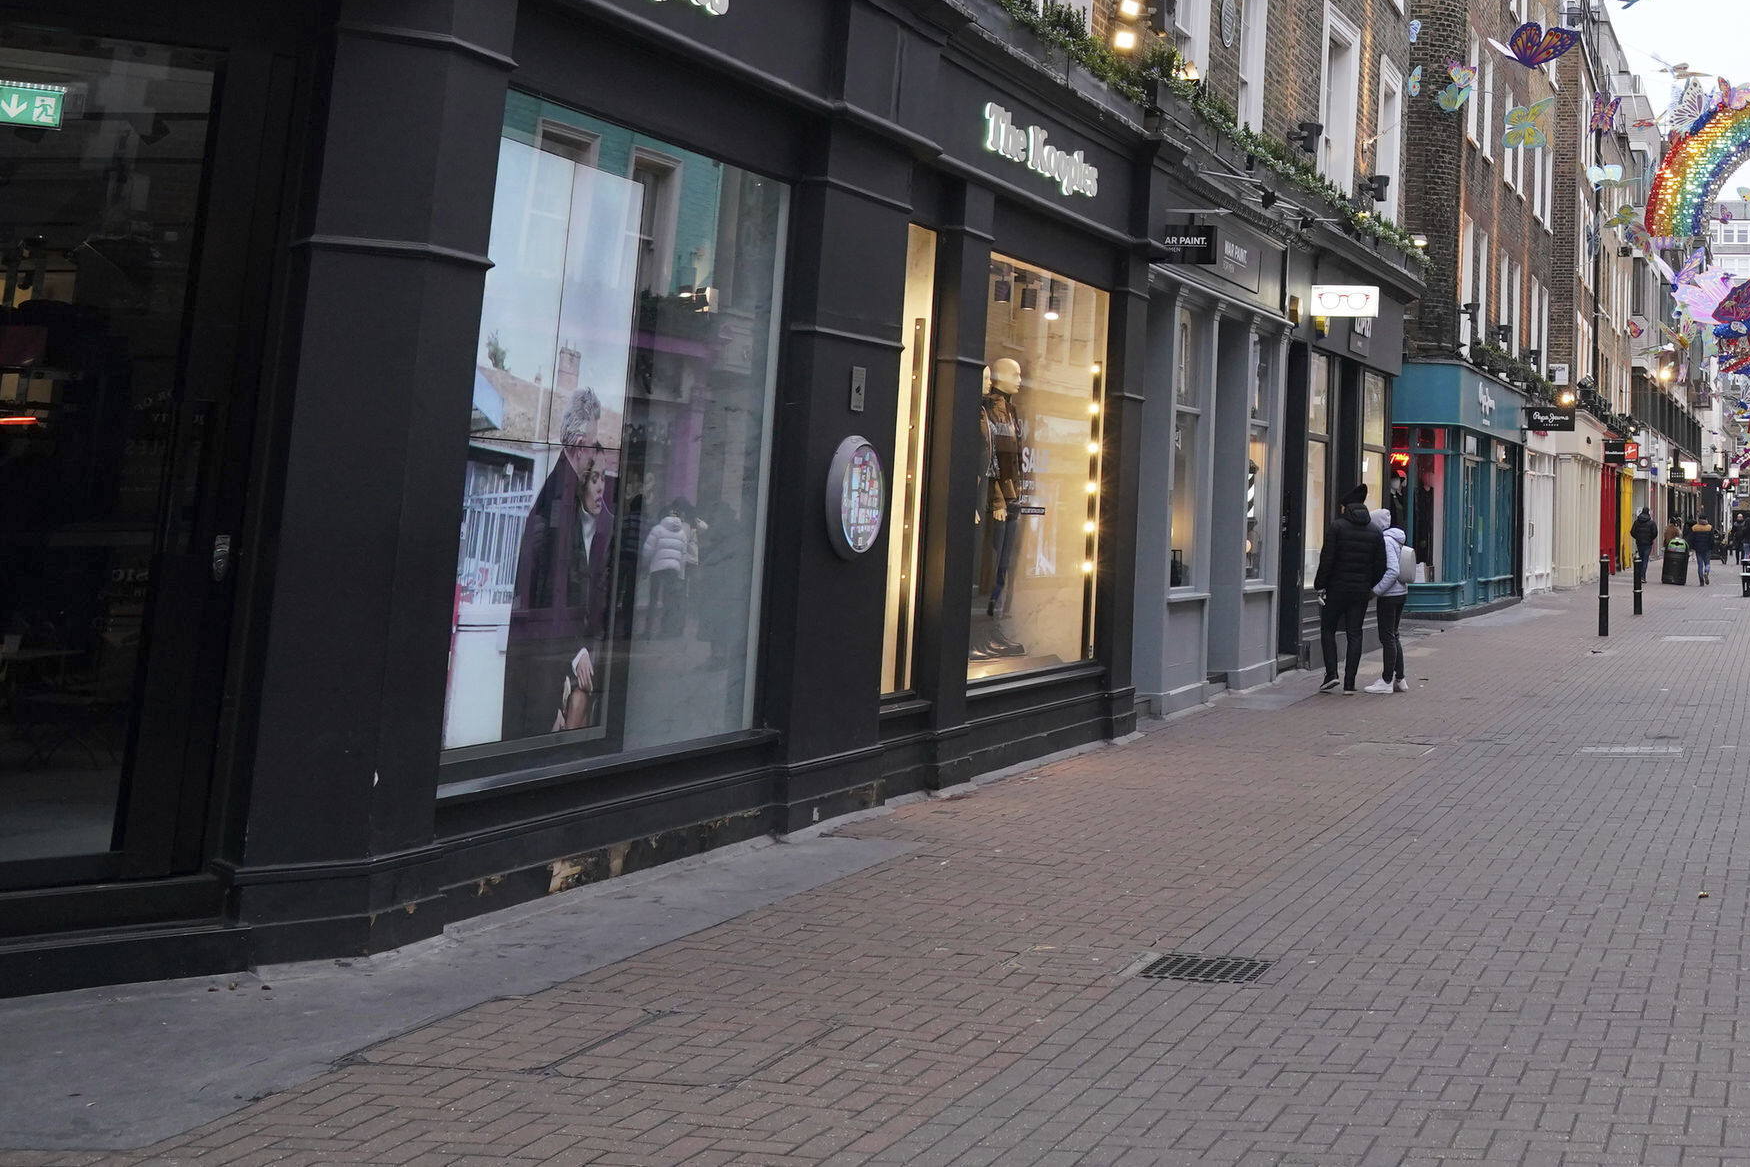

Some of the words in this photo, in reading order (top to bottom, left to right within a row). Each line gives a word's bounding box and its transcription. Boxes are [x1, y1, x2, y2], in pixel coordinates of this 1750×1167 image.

[985, 102, 1027, 162] The
[1027, 125, 1098, 197] Kooples
[1164, 237, 1178, 245] AR
[1179, 237, 1208, 245] PAINT.
[1021, 446, 1049, 473] SALE
